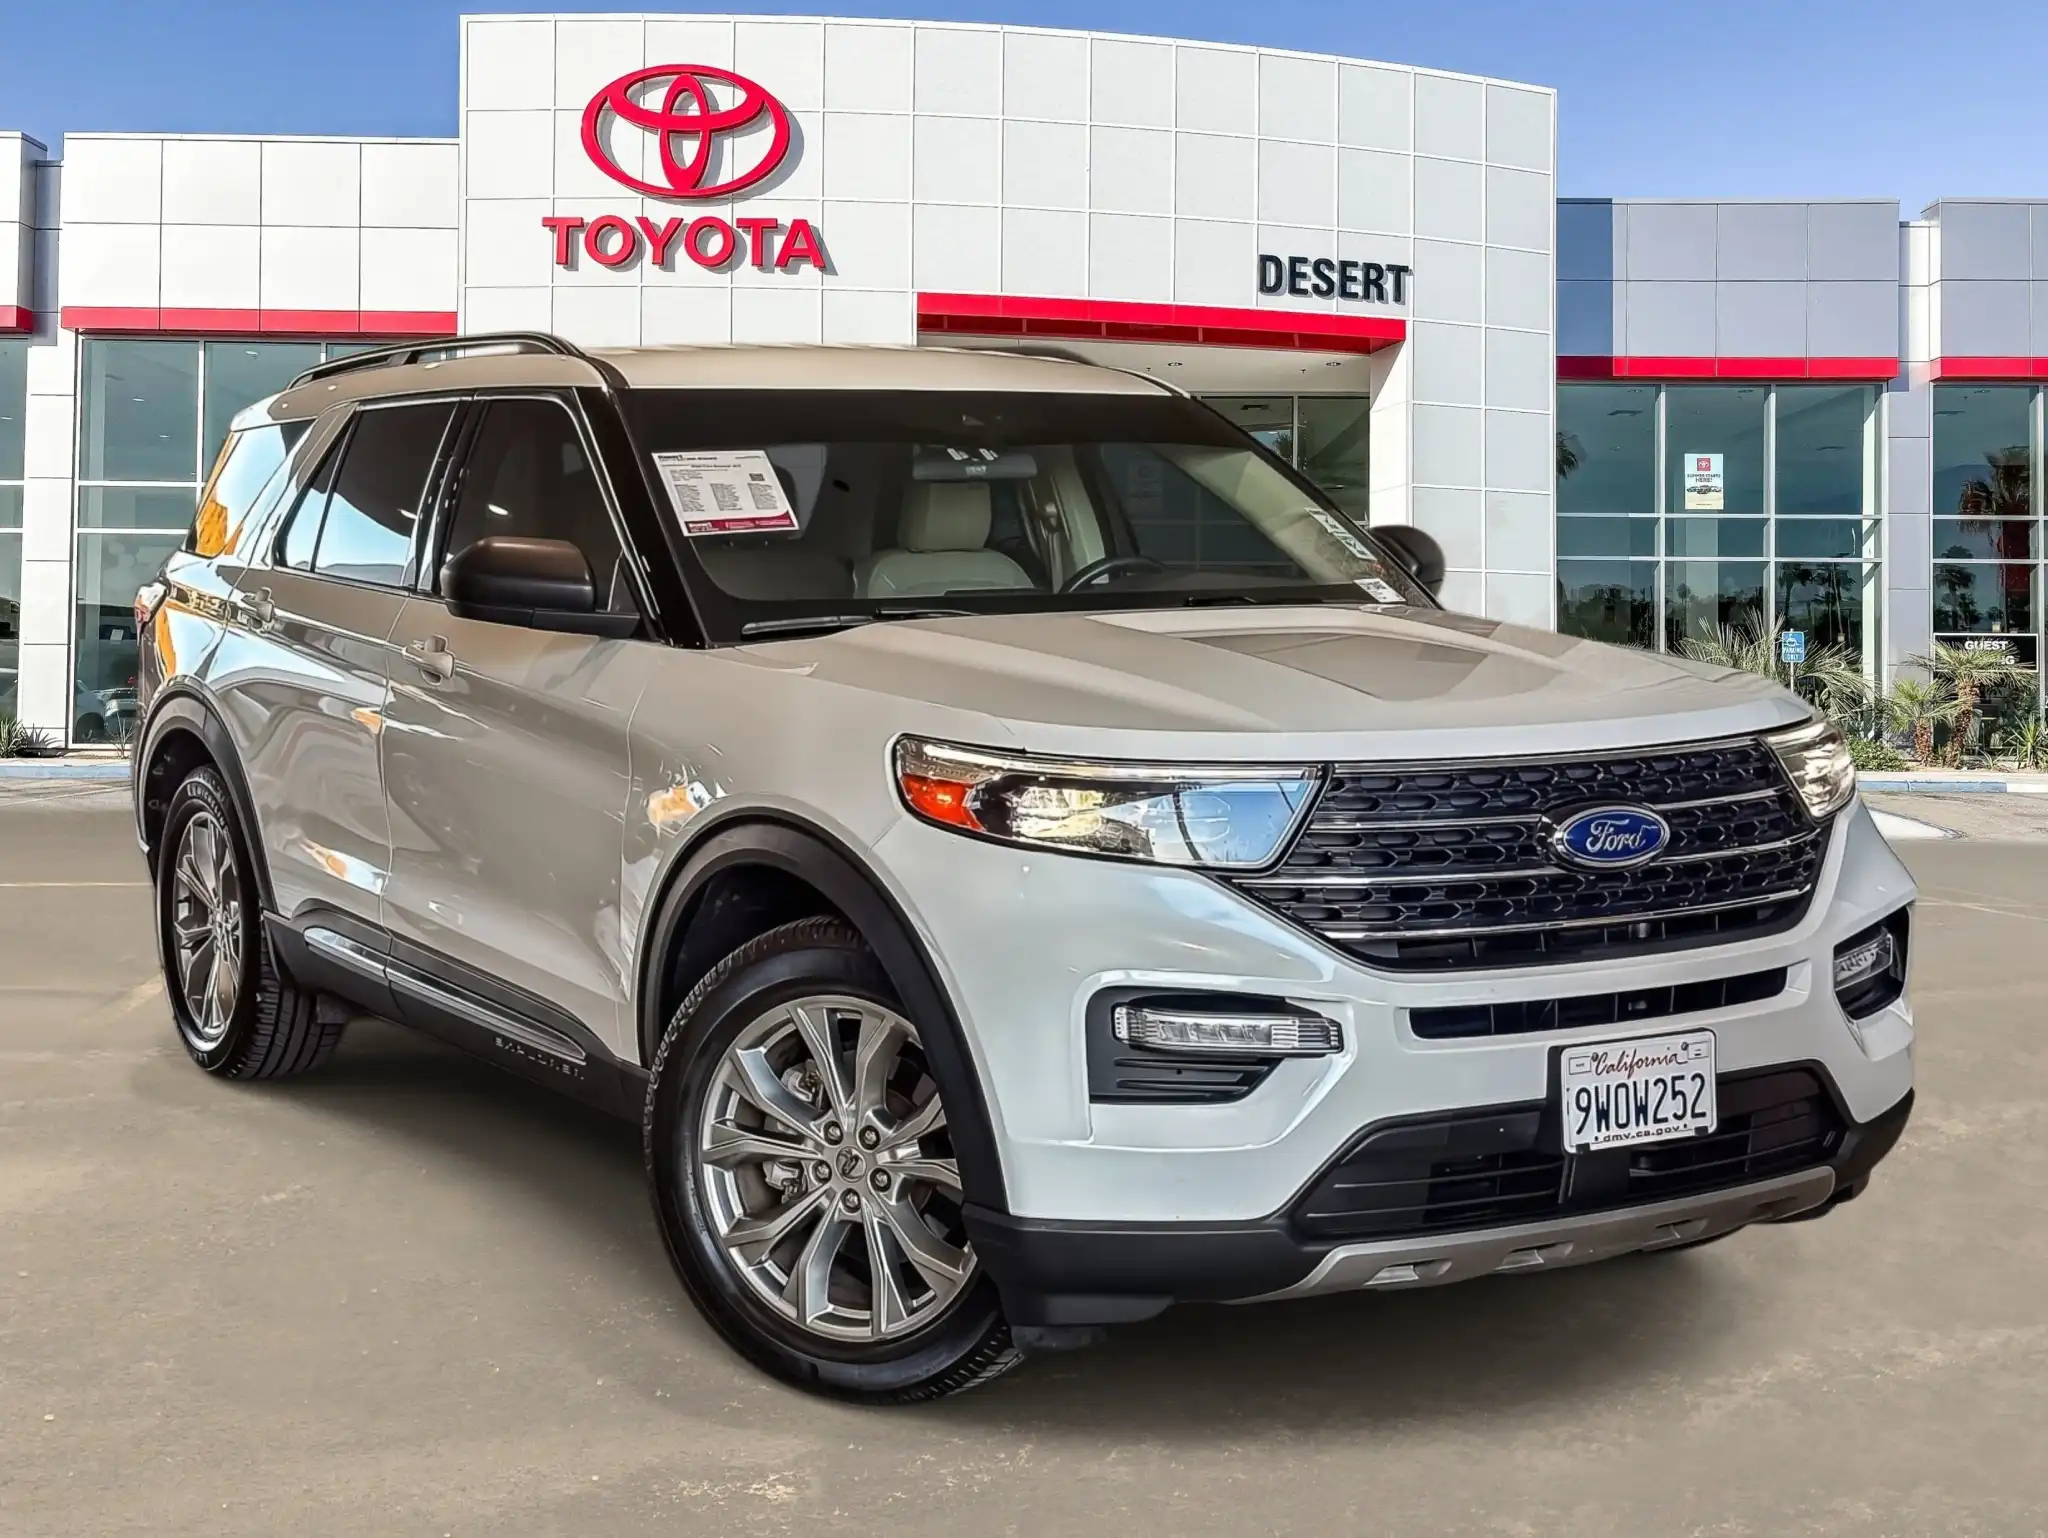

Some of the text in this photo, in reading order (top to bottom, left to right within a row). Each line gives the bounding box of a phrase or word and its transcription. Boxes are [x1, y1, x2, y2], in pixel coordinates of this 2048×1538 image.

[542, 215, 826, 272] TOYOTA
[1258, 254, 1410, 302] DESERT
[1964, 640, 2008, 650] GUEST
[1585, 818, 1659, 853] Ford
[1595, 1047, 1688, 1079] California
[1603, 1124, 1680, 1142] dmv.ca.gov
